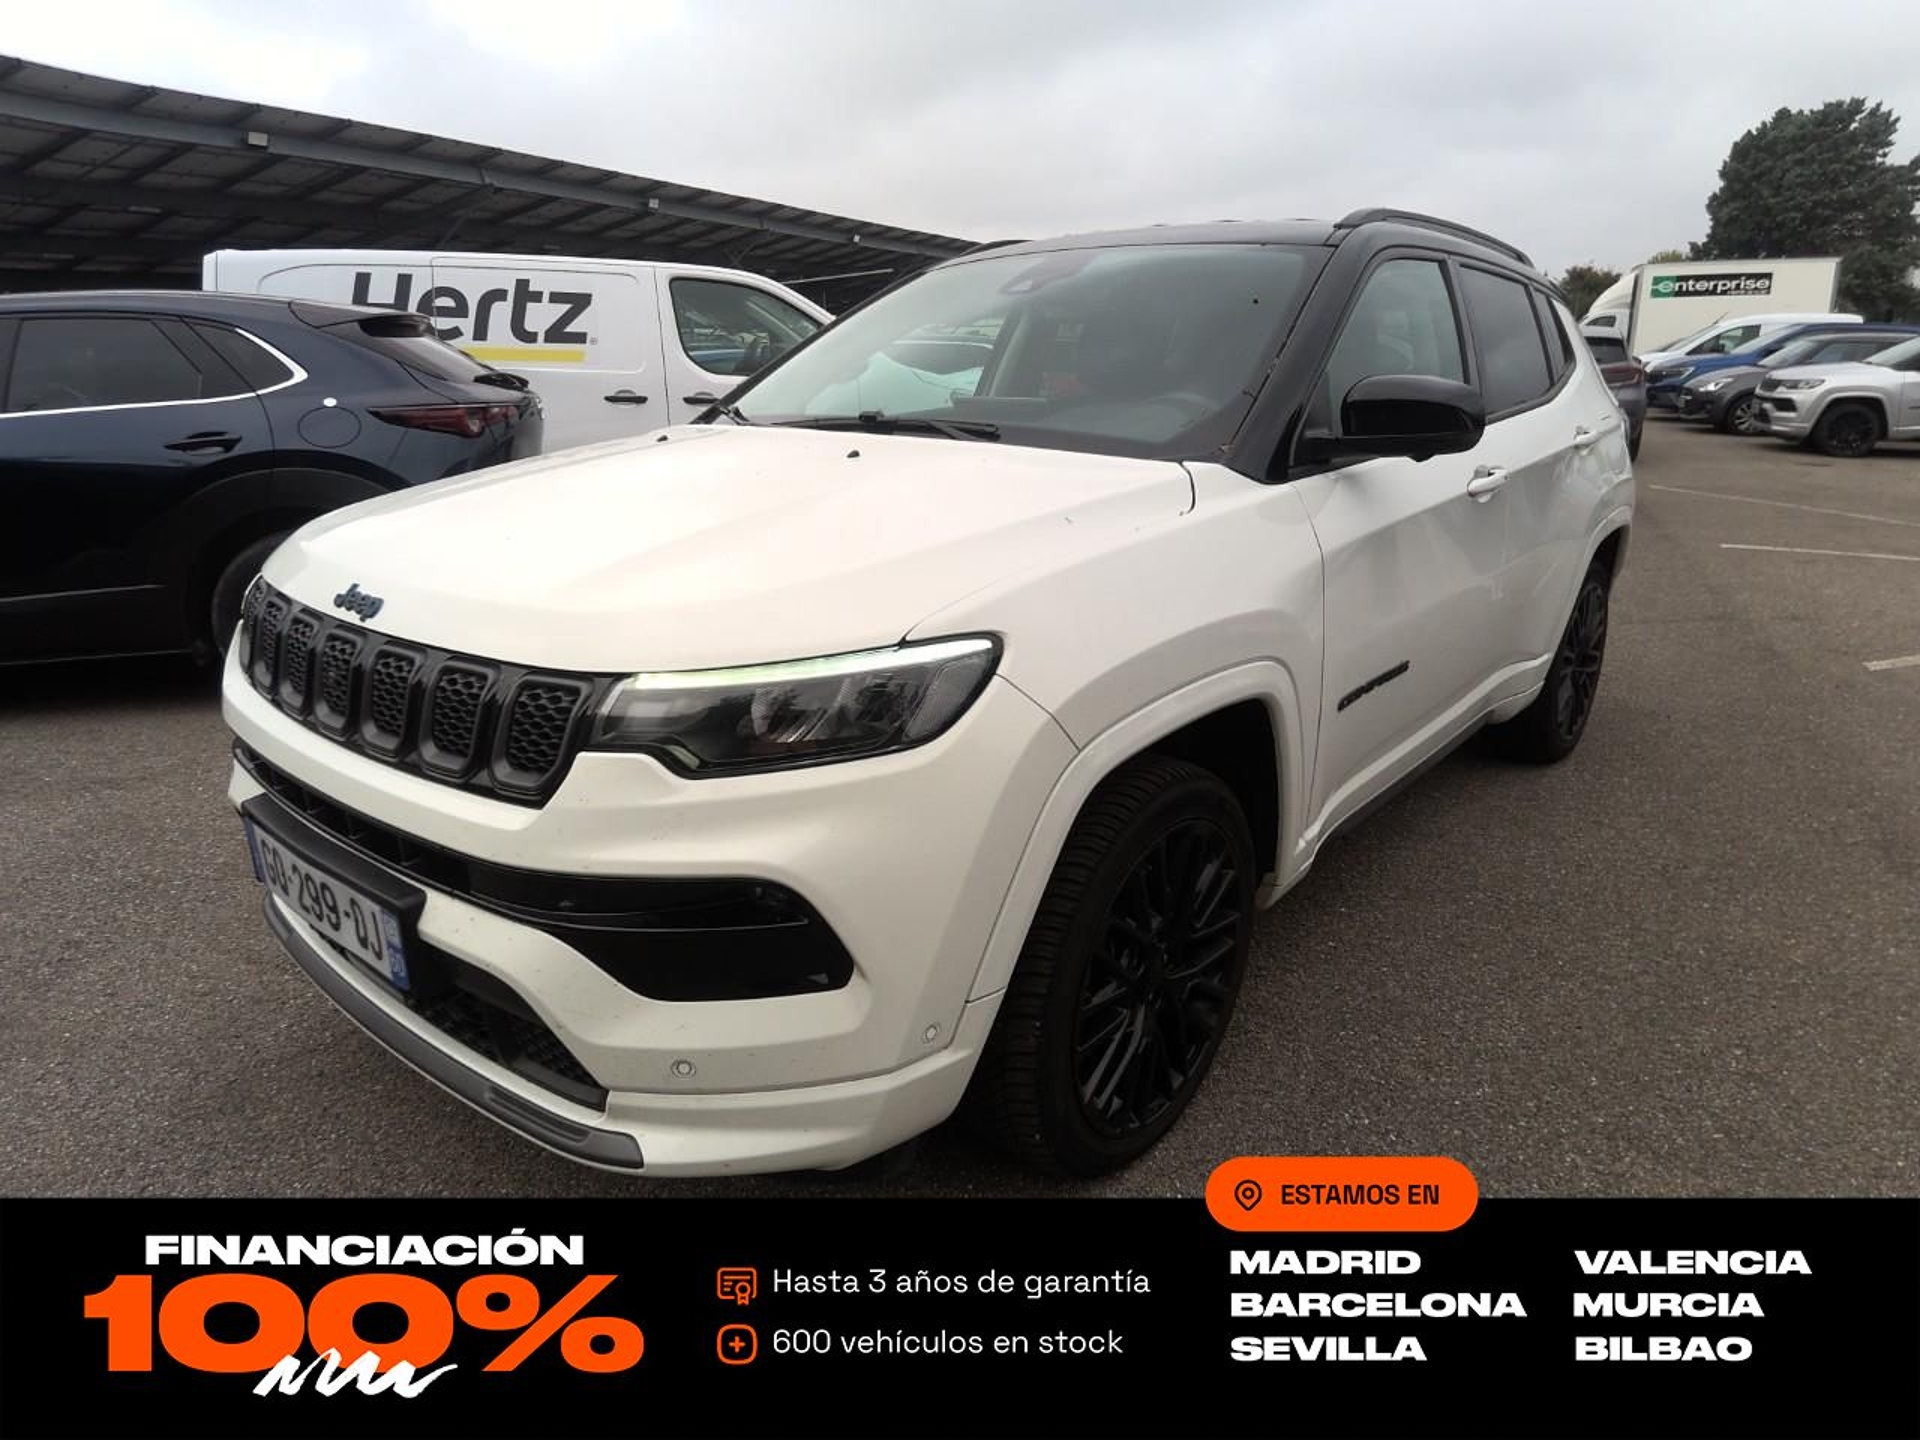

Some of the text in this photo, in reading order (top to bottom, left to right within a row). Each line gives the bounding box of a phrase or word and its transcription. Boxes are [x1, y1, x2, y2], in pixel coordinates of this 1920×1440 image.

[1651, 276, 1770, 294] enterprise
[352, 272, 593, 344] Hertz
[333, 583, 384, 622] Jeep
